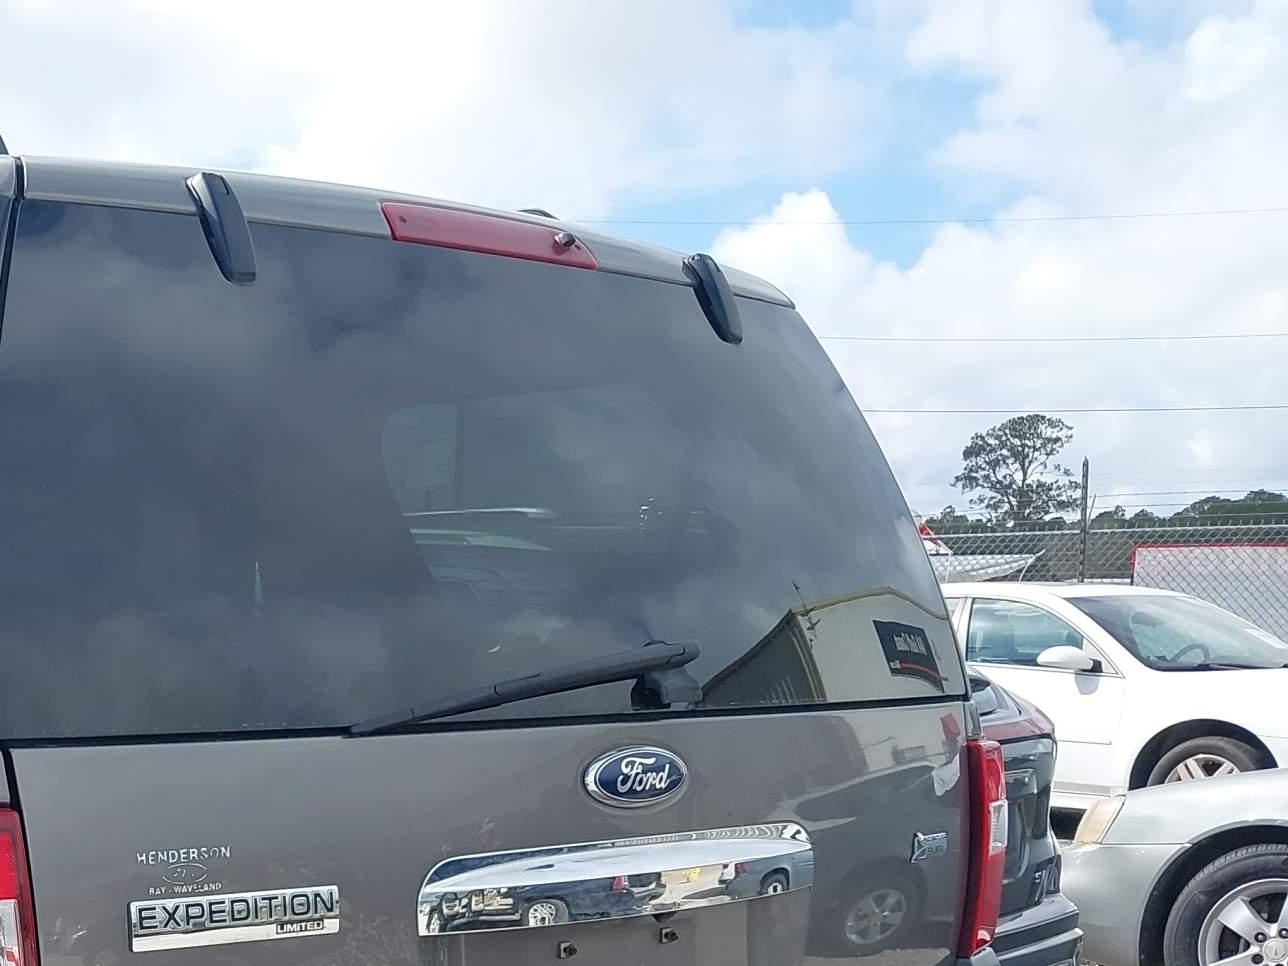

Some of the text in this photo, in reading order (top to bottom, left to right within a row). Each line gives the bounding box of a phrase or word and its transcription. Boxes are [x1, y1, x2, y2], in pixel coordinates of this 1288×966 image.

[617, 757, 672, 793] Ford
[136, 846, 231, 865] HENDERSON
[149, 882, 222, 896] BAY WAVELAND
[137, 891, 335, 930] EXPEDITION
[277, 920, 324, 934] LIMITED
